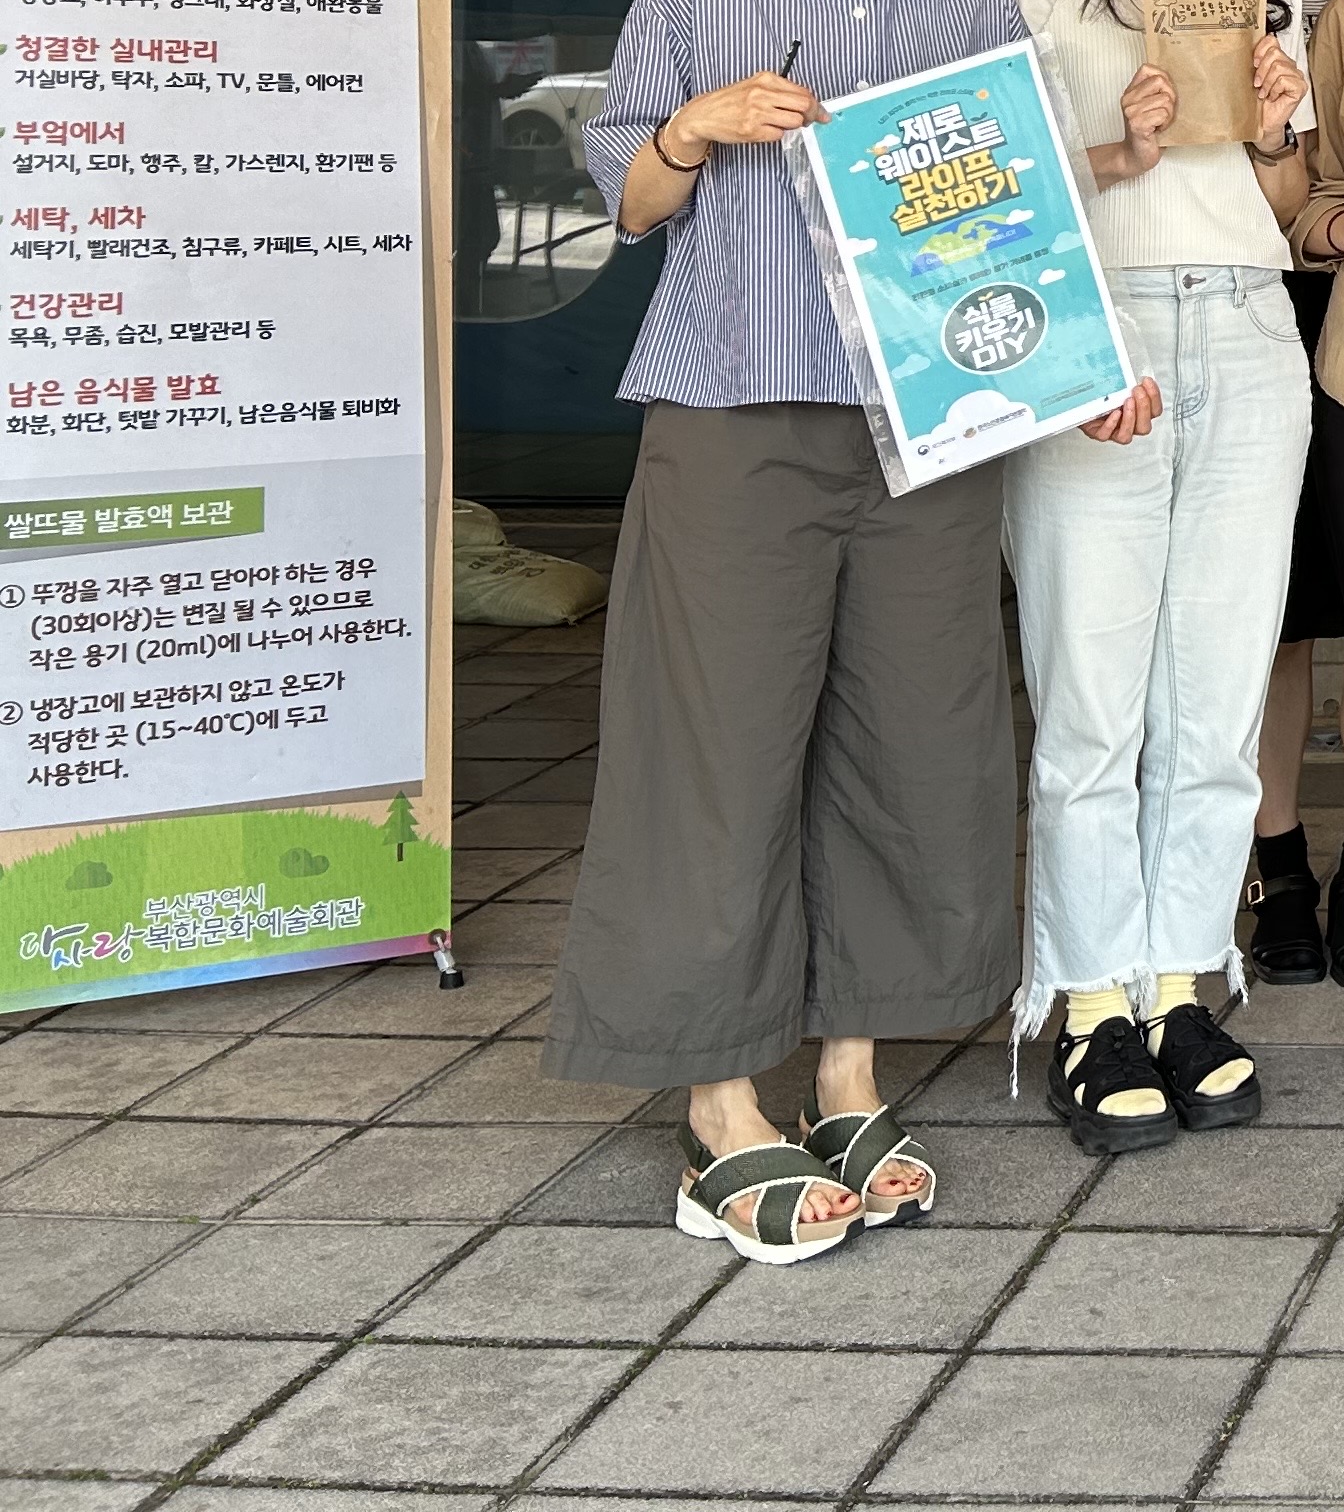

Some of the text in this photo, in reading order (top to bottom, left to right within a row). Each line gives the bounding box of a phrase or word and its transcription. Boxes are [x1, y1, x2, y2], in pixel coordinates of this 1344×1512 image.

[15, 34, 218, 64] 청결한 실내관리
[112, 70, 159, 93] 탁자,
[164, 72, 211, 93] 소파,
[216, 72, 251, 94] TV,
[256, 72, 301, 94] 문틀,
[306, 74, 364, 93] 에어컨
[898, 103, 967, 144] 제로
[12, 152, 398, 176] 설거지, 도마, 행주, 칼, 가스렌지, 환기팬 등
[875, 118, 1005, 181] 웨이스트
[899, 149, 997, 201] 라이프
[10, 205, 146, 234] 세탁, 세차
[893, 169, 1019, 233] 실천하기
[10, 234, 413, 261] 세탁기, 빨래건조, 침구류, 카페트, 시트, 세차
[10, 292, 123, 320] 건강관리
[962, 292, 1016, 325] 식물
[8, 319, 276, 349] 목욕, 무좀, 습진, 모발관리 등
[955, 312, 1036, 352] 키우기
[974, 339, 1026, 370] DIY
[8, 373, 222, 409] 남은 음식물 발효
[6, 397, 401, 436] 화분, 화단, 텃밭 가꾸기, 남은음식물 퇴비화
[4, 500, 234, 540] 쌀뜨물 발효액 보관
[31, 577, 101, 606] 뚜껑을
[105, 572, 154, 599] 자주
[160, 570, 204, 596] 열고
[209, 563, 280, 592] 닫아야
[285, 561, 330, 586] 하는
[335, 558, 378, 582] 경우
[30, 589, 374, 642] (30회이상)는 변질 될 수 있으므로
[29, 617, 413, 672] 작은 용기 (20ml)에 나누어 사용한다.
[30, 690, 126, 723] 냉장고에
[132, 682, 222, 710] 보관하지
[228, 676, 274, 704] 않고
[279, 670, 346, 697] 온도가
[28, 727, 99, 756] 적당한
[105, 722, 128, 748] 곳
[286, 704, 329, 728] 두고
[27, 758, 129, 789] 사용한다.
[146, 885, 265, 919] 부산광역시
[146, 899, 363, 950] 복합문화예술회관
